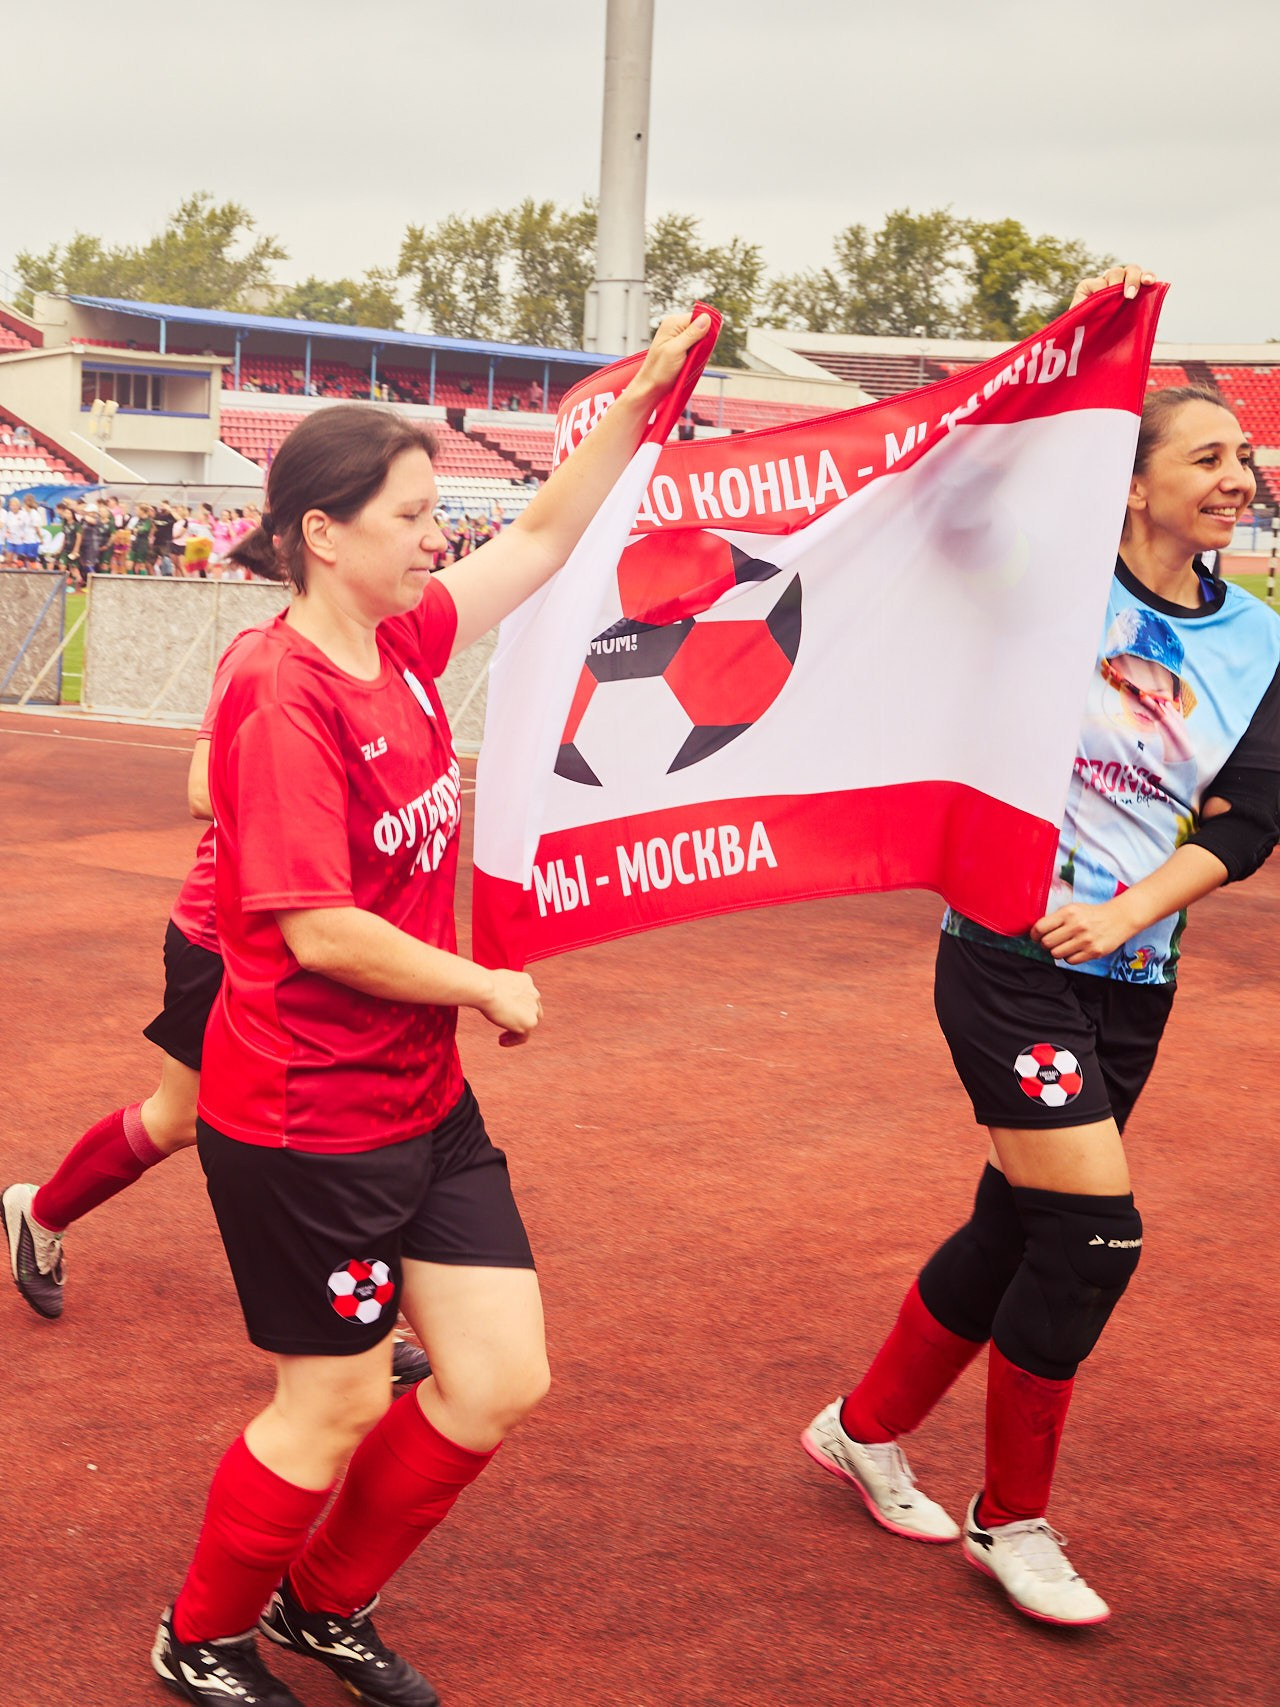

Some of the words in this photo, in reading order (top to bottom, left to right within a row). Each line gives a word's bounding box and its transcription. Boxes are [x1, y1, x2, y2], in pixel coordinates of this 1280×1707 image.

[688, 449, 849, 516] КОНЦА
[532, 854, 590, 917] МЫ
[616, 821, 778, 897] МОСКВА
